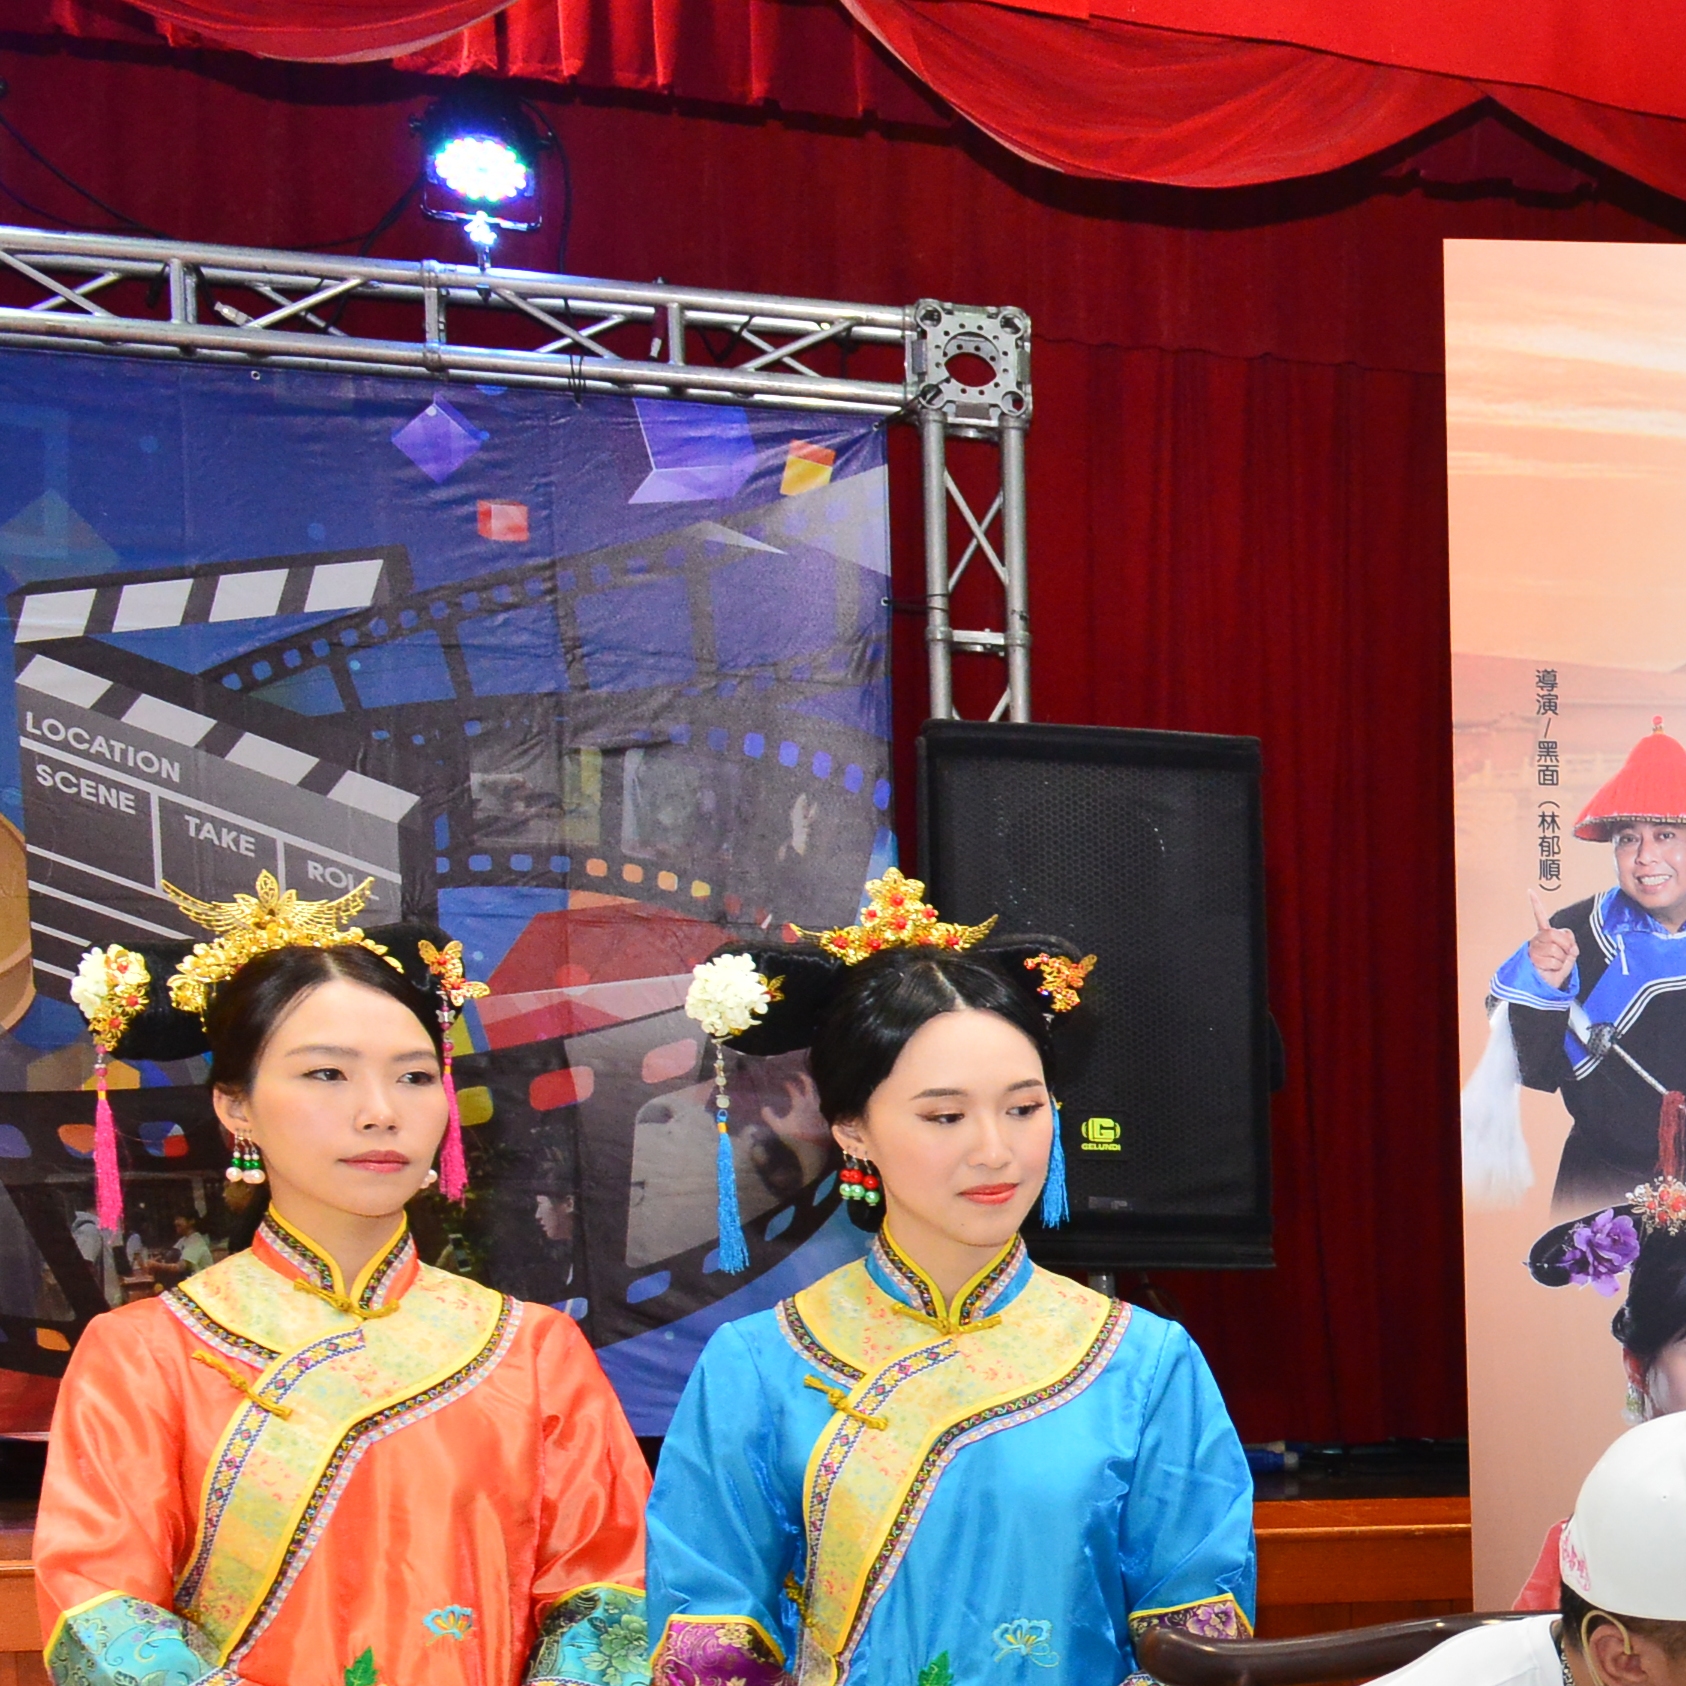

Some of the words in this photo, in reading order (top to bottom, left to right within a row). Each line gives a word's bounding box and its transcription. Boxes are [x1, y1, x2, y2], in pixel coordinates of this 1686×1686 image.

[25, 711, 182, 784] LOCATION
[35, 763, 136, 815] SCENE
[184, 814, 257, 858] TAKE
